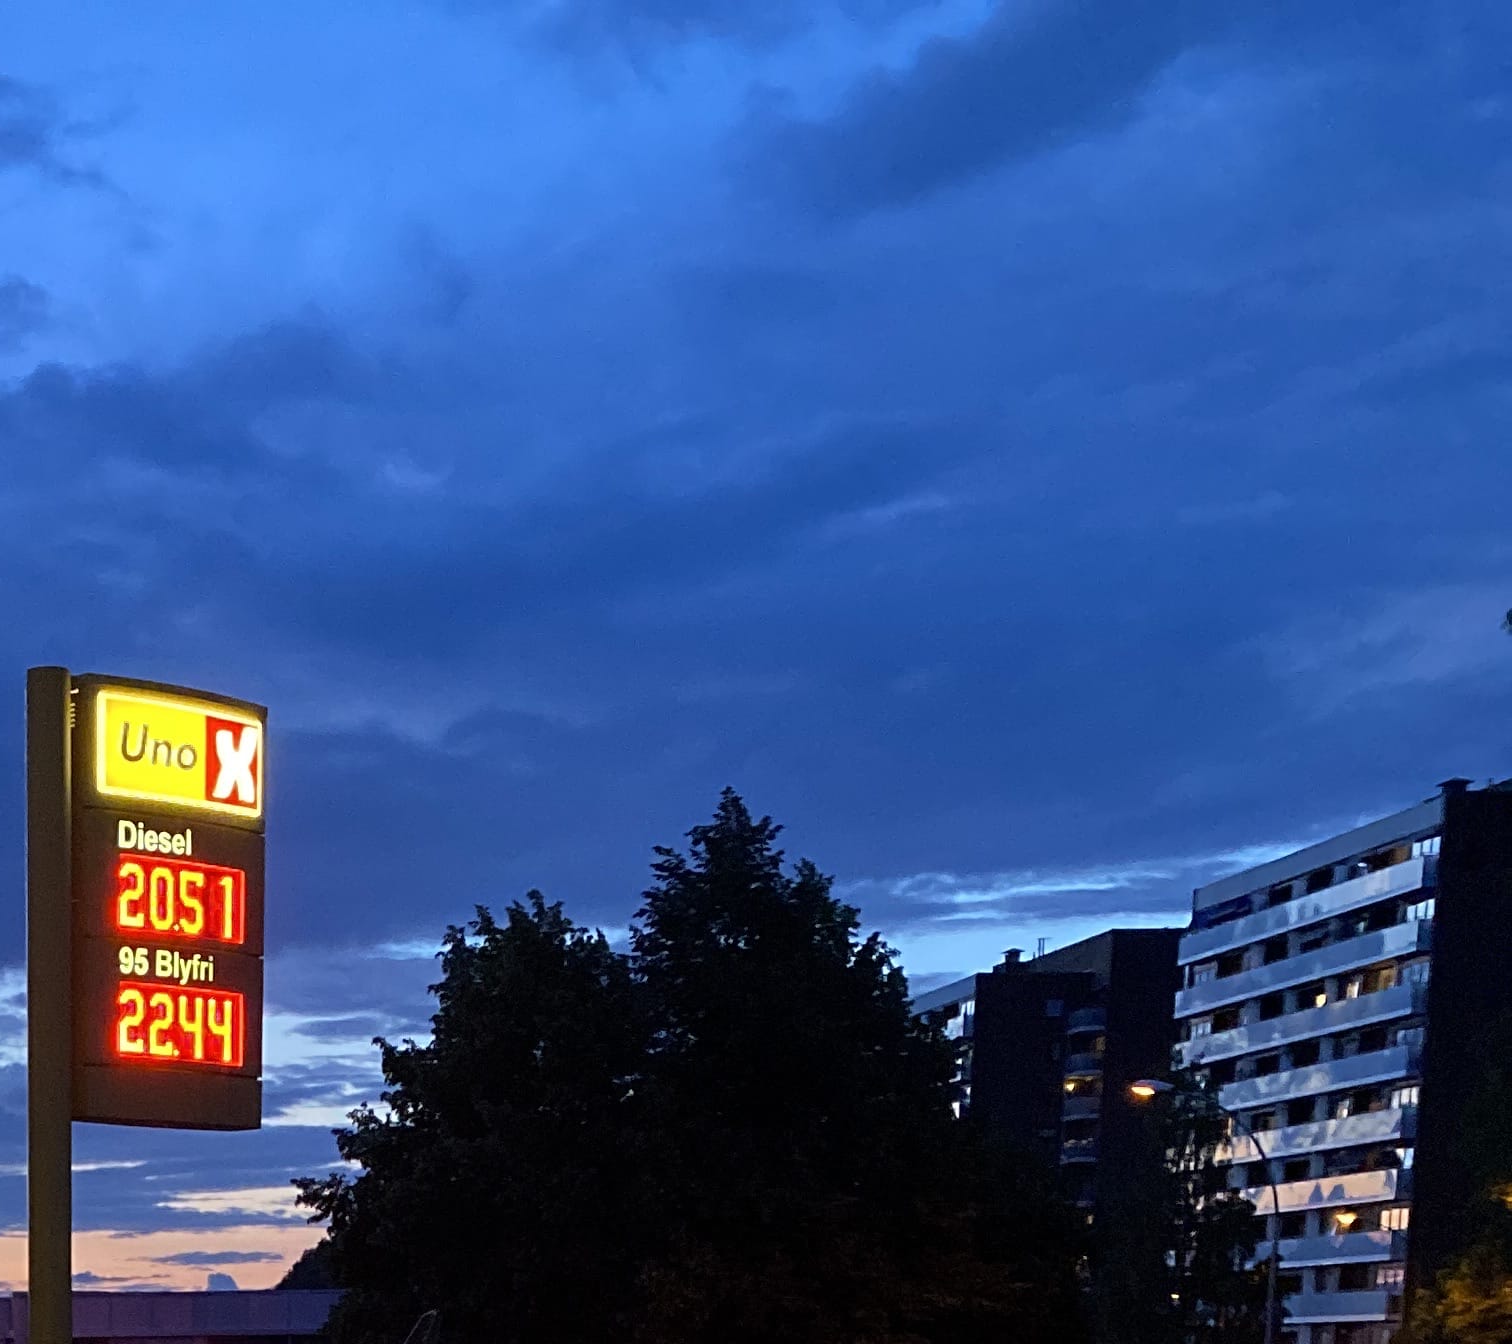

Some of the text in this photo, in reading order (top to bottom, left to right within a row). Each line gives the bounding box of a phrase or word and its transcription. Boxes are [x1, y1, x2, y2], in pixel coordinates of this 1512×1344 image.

[121, 721, 258, 804] Uno X
[117, 819, 192, 857] Diesel
[118, 862, 234, 940] 20.51
[118, 946, 215, 986] 95 Blyfri
[118, 988, 234, 1063] 22.44
